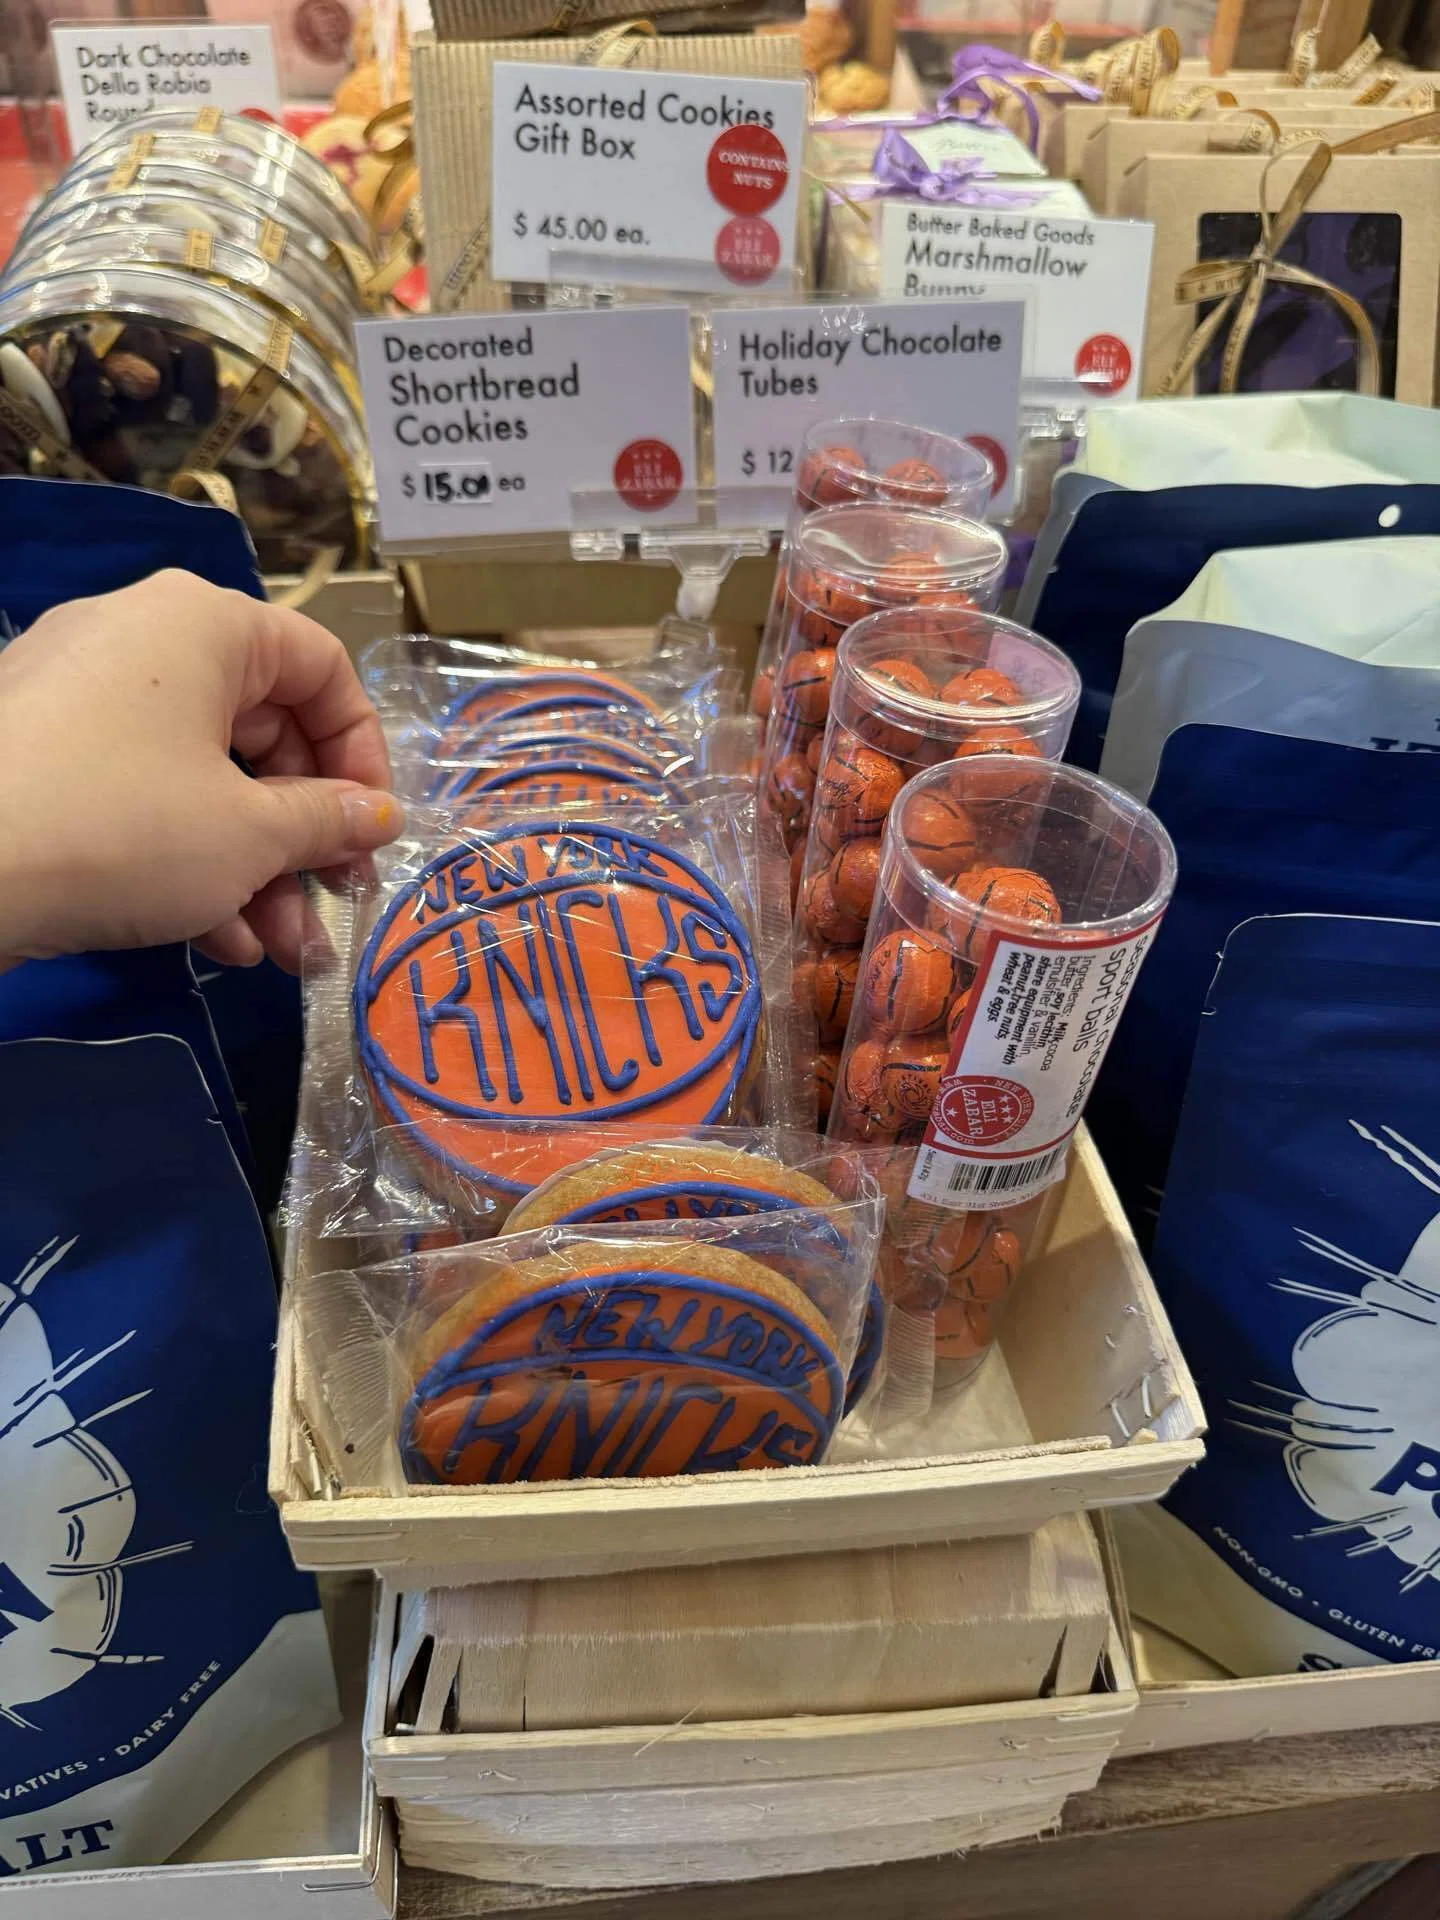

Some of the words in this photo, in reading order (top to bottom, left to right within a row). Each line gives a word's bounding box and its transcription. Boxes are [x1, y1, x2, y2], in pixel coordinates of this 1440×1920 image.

[76, 44, 132, 68] Dark
[138, 43, 251, 67] Chocolate
[81, 71, 140, 96] Della
[147, 70, 212, 94] Robia
[515, 81, 646, 121] Assorted
[658, 93, 774, 129] Cookies
[515, 122, 571, 153] Gift
[582, 128, 636, 160] Box
[719, 151, 791, 172] CONTAINS
[733, 172, 774, 190] NUTS
[514, 212, 527, 239] $
[537, 214, 607, 241] 45.00
[615, 228, 650, 246] ea.
[907, 211, 962, 235] Butter
[969, 216, 1028, 240] Baked
[1033, 222, 1095, 246] Goods
[905, 237, 1088, 278] Marshmallow
[384, 326, 534, 363] Decorated
[740, 330, 850, 366] Holiday
[861, 321, 1002, 356] Chocolate
[390, 362, 580, 406] Shortbread
[740, 364, 819, 397] Tubes
[395, 409, 529, 446] Cookies
[741, 450, 756, 477] $
[402, 475, 415, 498] $
[500, 475, 526, 490] ea
[410, 845, 528, 923] NEW
[1001, 951, 1021, 985] wheat
[1032, 955, 1052, 986] share
[1040, 956, 1066, 1008] emulsifier
[1061, 956, 1080, 988] butter
[1062, 955, 1097, 1017] Ingredients:
[1090, 947, 1127, 1004] sport
[1102, 935, 1149, 1027] seasonal
[408, 888, 743, 1105] KNICKS
[986, 997, 1004, 1022] eggs.
[997, 986, 1010, 996] &
[995, 1016, 1012, 1041] nuts,
[1010, 988, 1038, 1043] equipment
[1034, 1009, 1049, 1018] &
[1072, 1006, 1102, 1052] balls
[1002, 1044, 1018, 1065] with
[1065, 1028, 1110, 1118] chocolate
[961, 1088, 984, 1137] ZABAR
[981, 1099, 998, 1123] ELI
[535, 1291, 700, 1356] NEW
[690, 1306, 821, 1395] YORK
[1213, 1526, 1304, 1598] NON-GMO
[1328, 1608, 1406, 1647] GLUTEN
[115, 1707, 175, 1757] DAIRY
[180, 1660, 222, 1703] FREE
